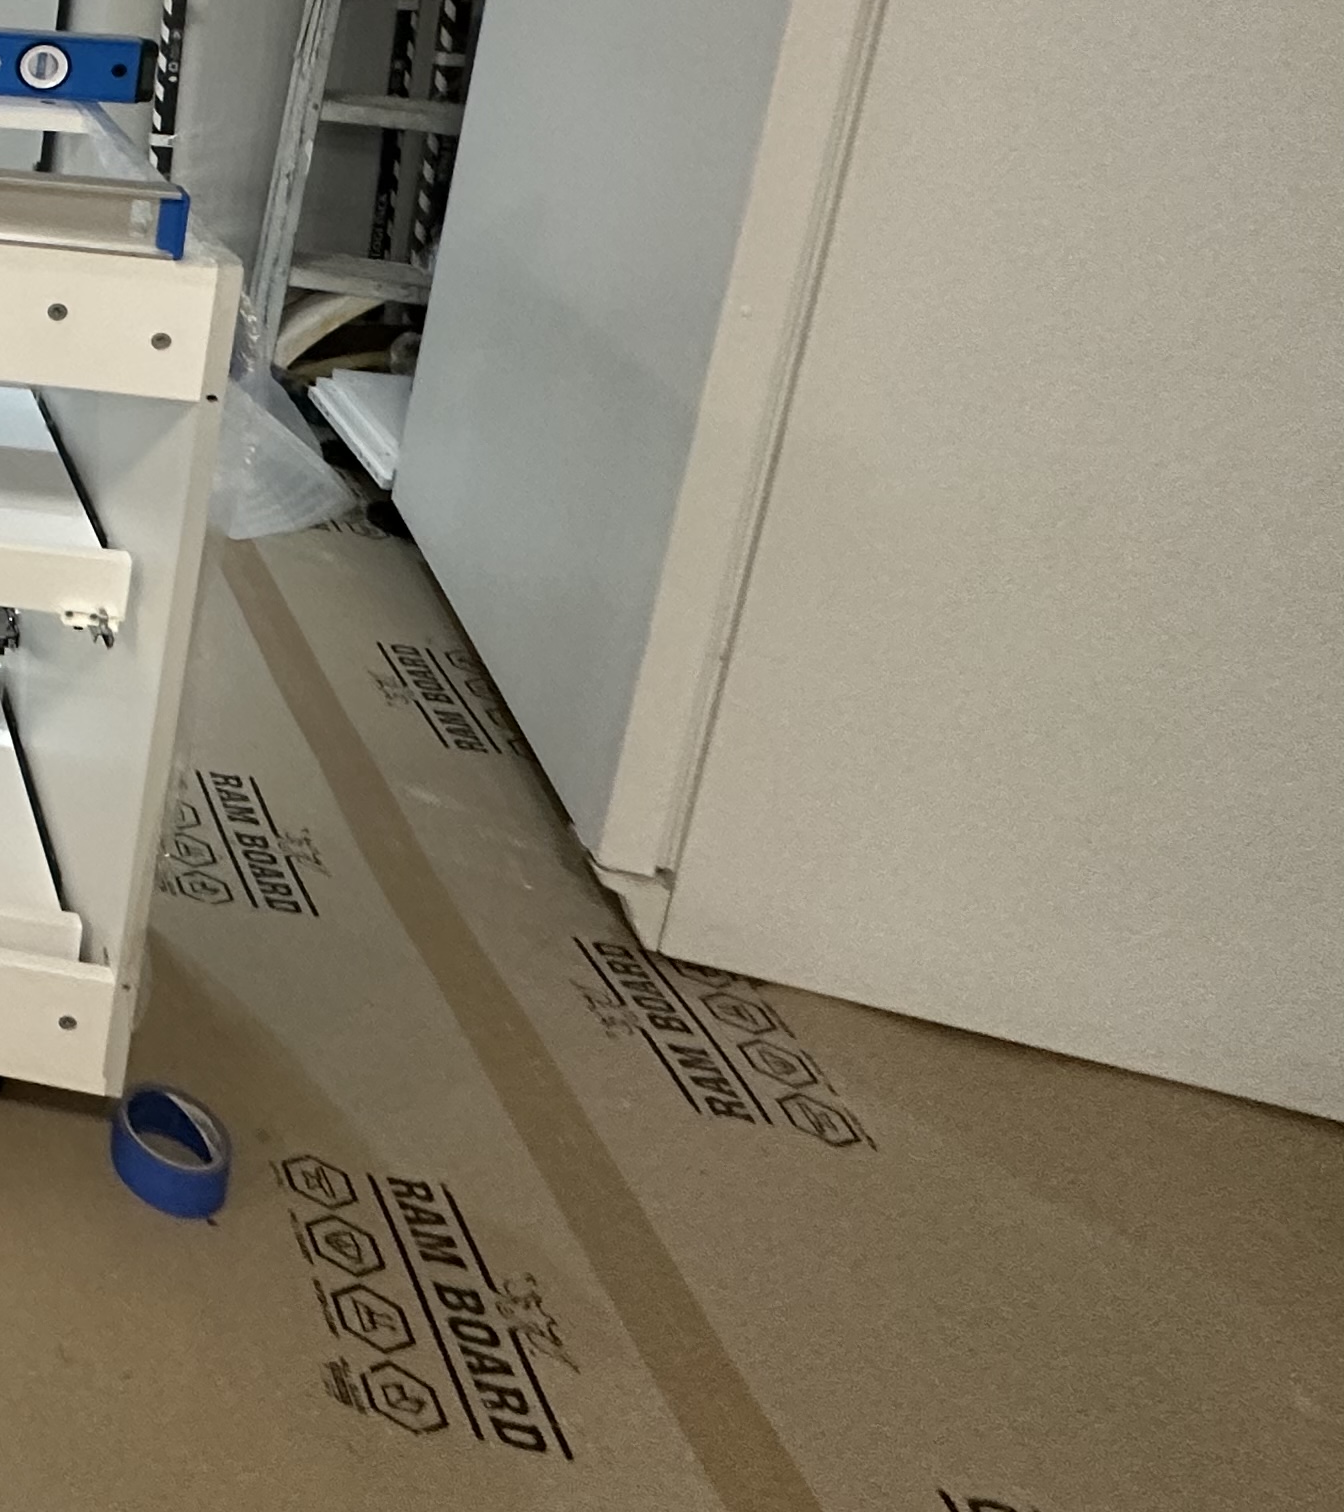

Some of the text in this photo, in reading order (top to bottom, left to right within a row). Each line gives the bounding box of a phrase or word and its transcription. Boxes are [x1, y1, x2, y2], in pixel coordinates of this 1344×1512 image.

[391, 644, 488, 753] RAM BOARD
[209, 771, 302, 914] RAM BOARD
[592, 941, 757, 1125] RAM BOARD
[386, 1176, 548, 1453] RAM BOARD
